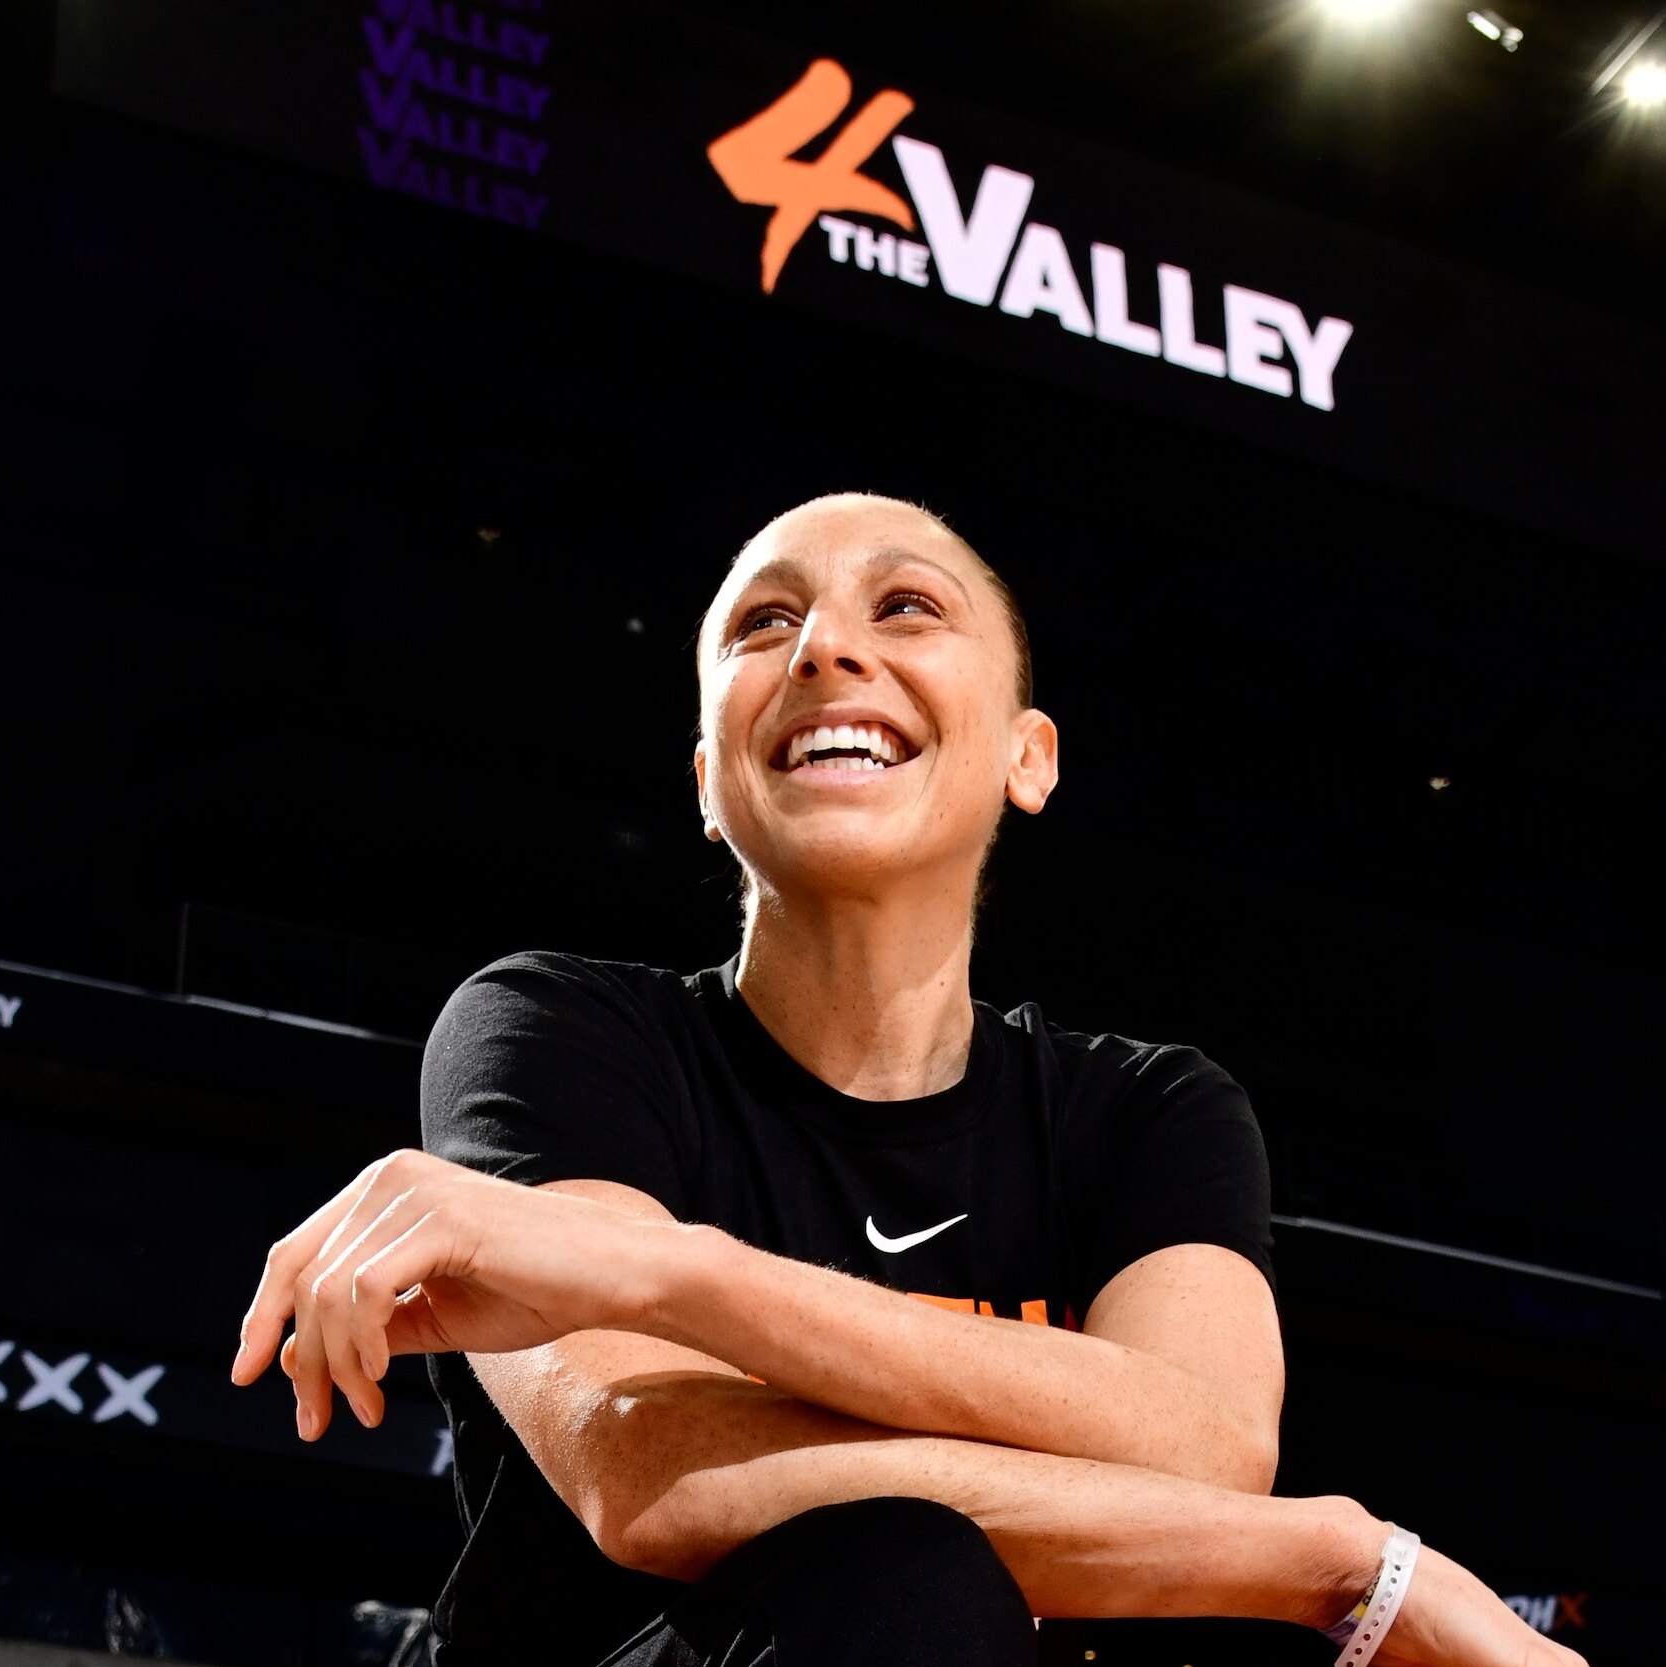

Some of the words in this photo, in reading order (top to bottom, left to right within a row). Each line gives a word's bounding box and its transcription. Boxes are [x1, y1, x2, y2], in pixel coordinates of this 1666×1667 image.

[706, 57, 915, 295] 4
[819, 214, 931, 288] THE
[891, 133, 1355, 412] VALLEY
